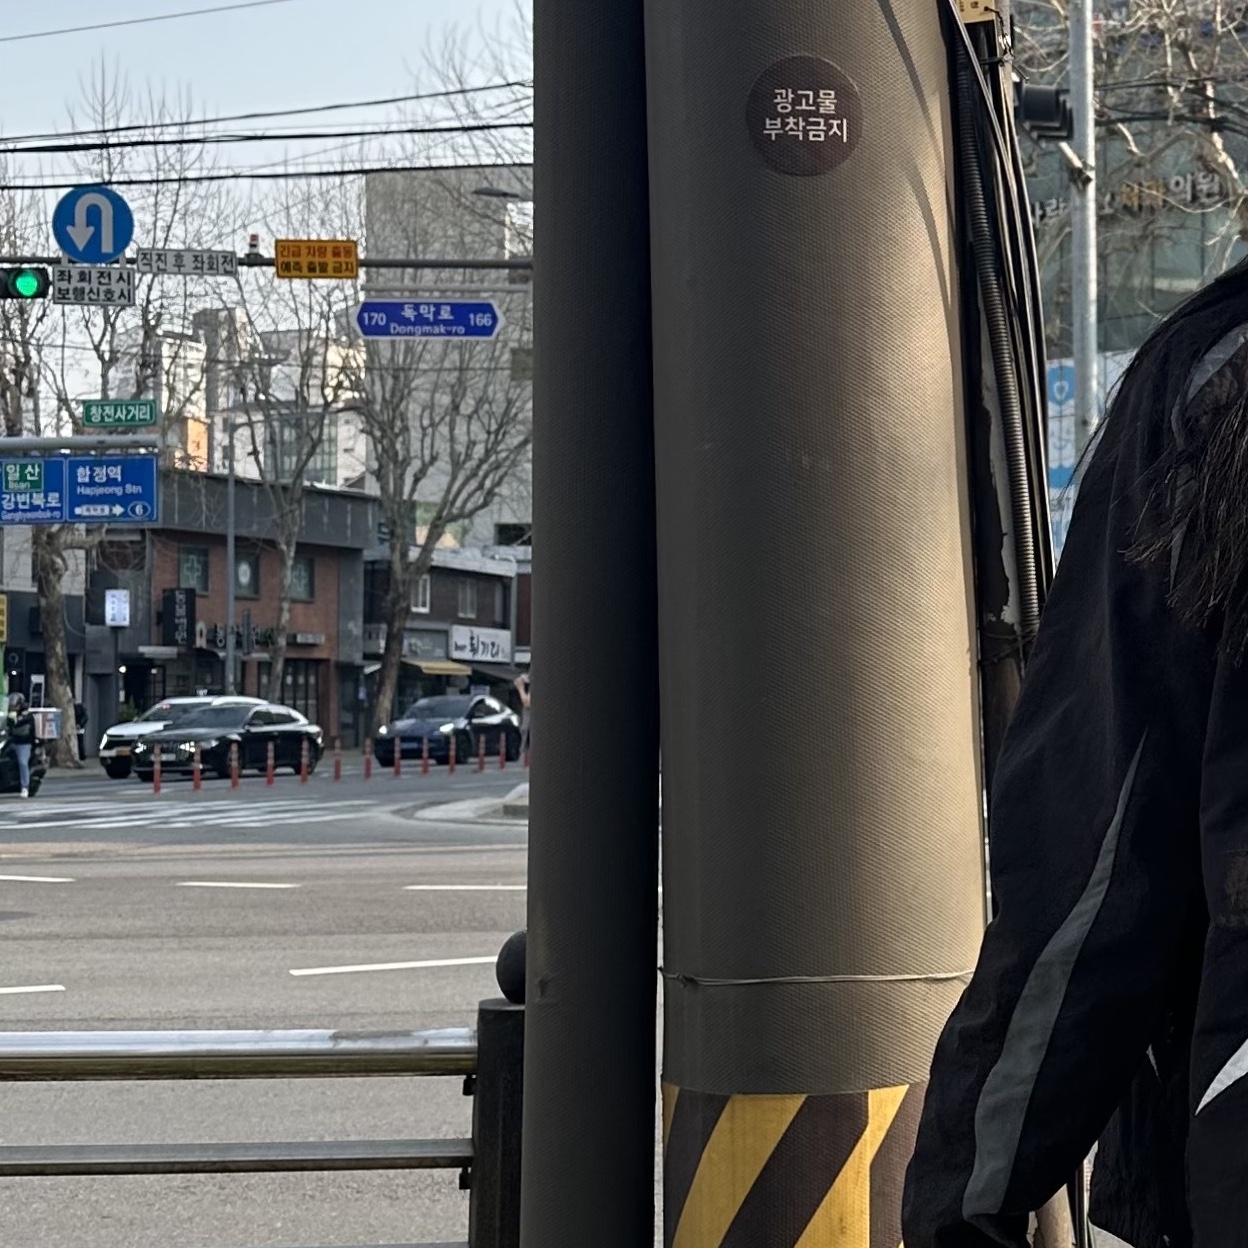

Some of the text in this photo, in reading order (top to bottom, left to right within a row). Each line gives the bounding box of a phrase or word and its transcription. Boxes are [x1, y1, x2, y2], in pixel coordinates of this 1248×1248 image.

[773, 88, 838, 114] 광고물
[763, 116, 848, 143] 부착금지
[280, 244, 302, 258] 긴급
[140, 252, 236, 275] 직진 후 좌회전
[332, 261, 354, 273] 금지
[57, 287, 132, 303] 보행신호시
[401, 304, 454, 322] 독막로
[363, 312, 493, 336] 170 Dongmak-ro 166
[90, 405, 151, 422] 창전사거리
[76, 465, 122, 484] 합정역
[134, 504, 144, 516] 6
